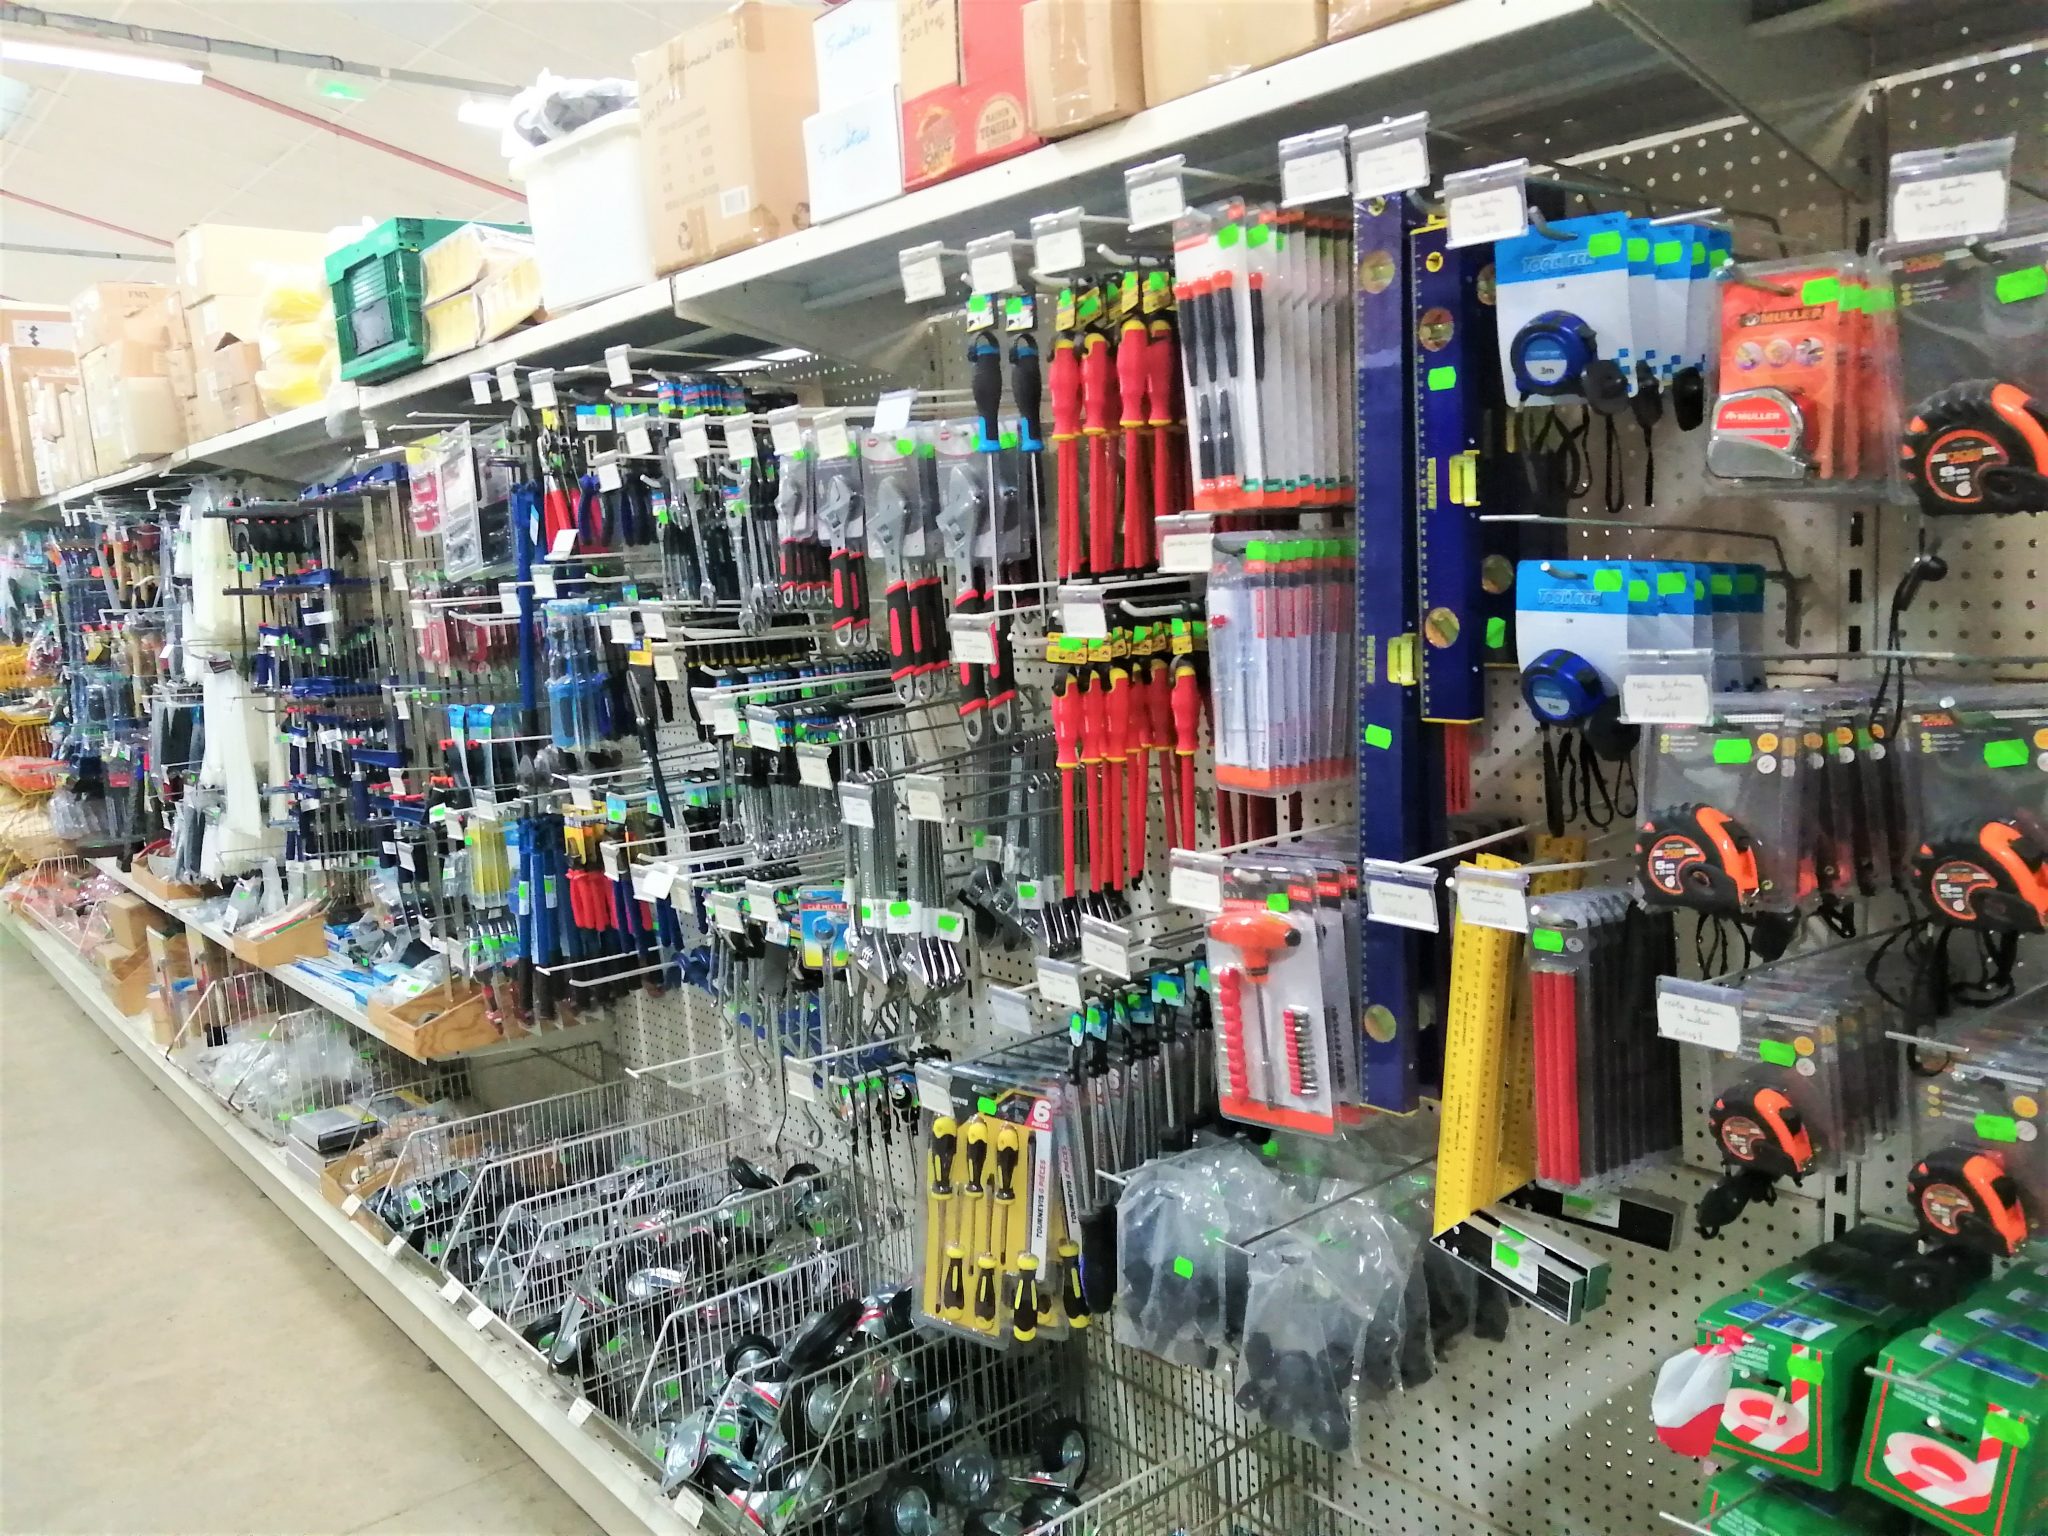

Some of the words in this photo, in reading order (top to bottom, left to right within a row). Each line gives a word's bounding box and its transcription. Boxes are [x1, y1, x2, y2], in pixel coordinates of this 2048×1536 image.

[1760, 307, 1824, 323] MULLER
[1738, 412, 1781, 421] MULLER
[1033, 1099, 1052, 1123] 6
[1036, 1194, 1046, 1239] TOURNEVIS
